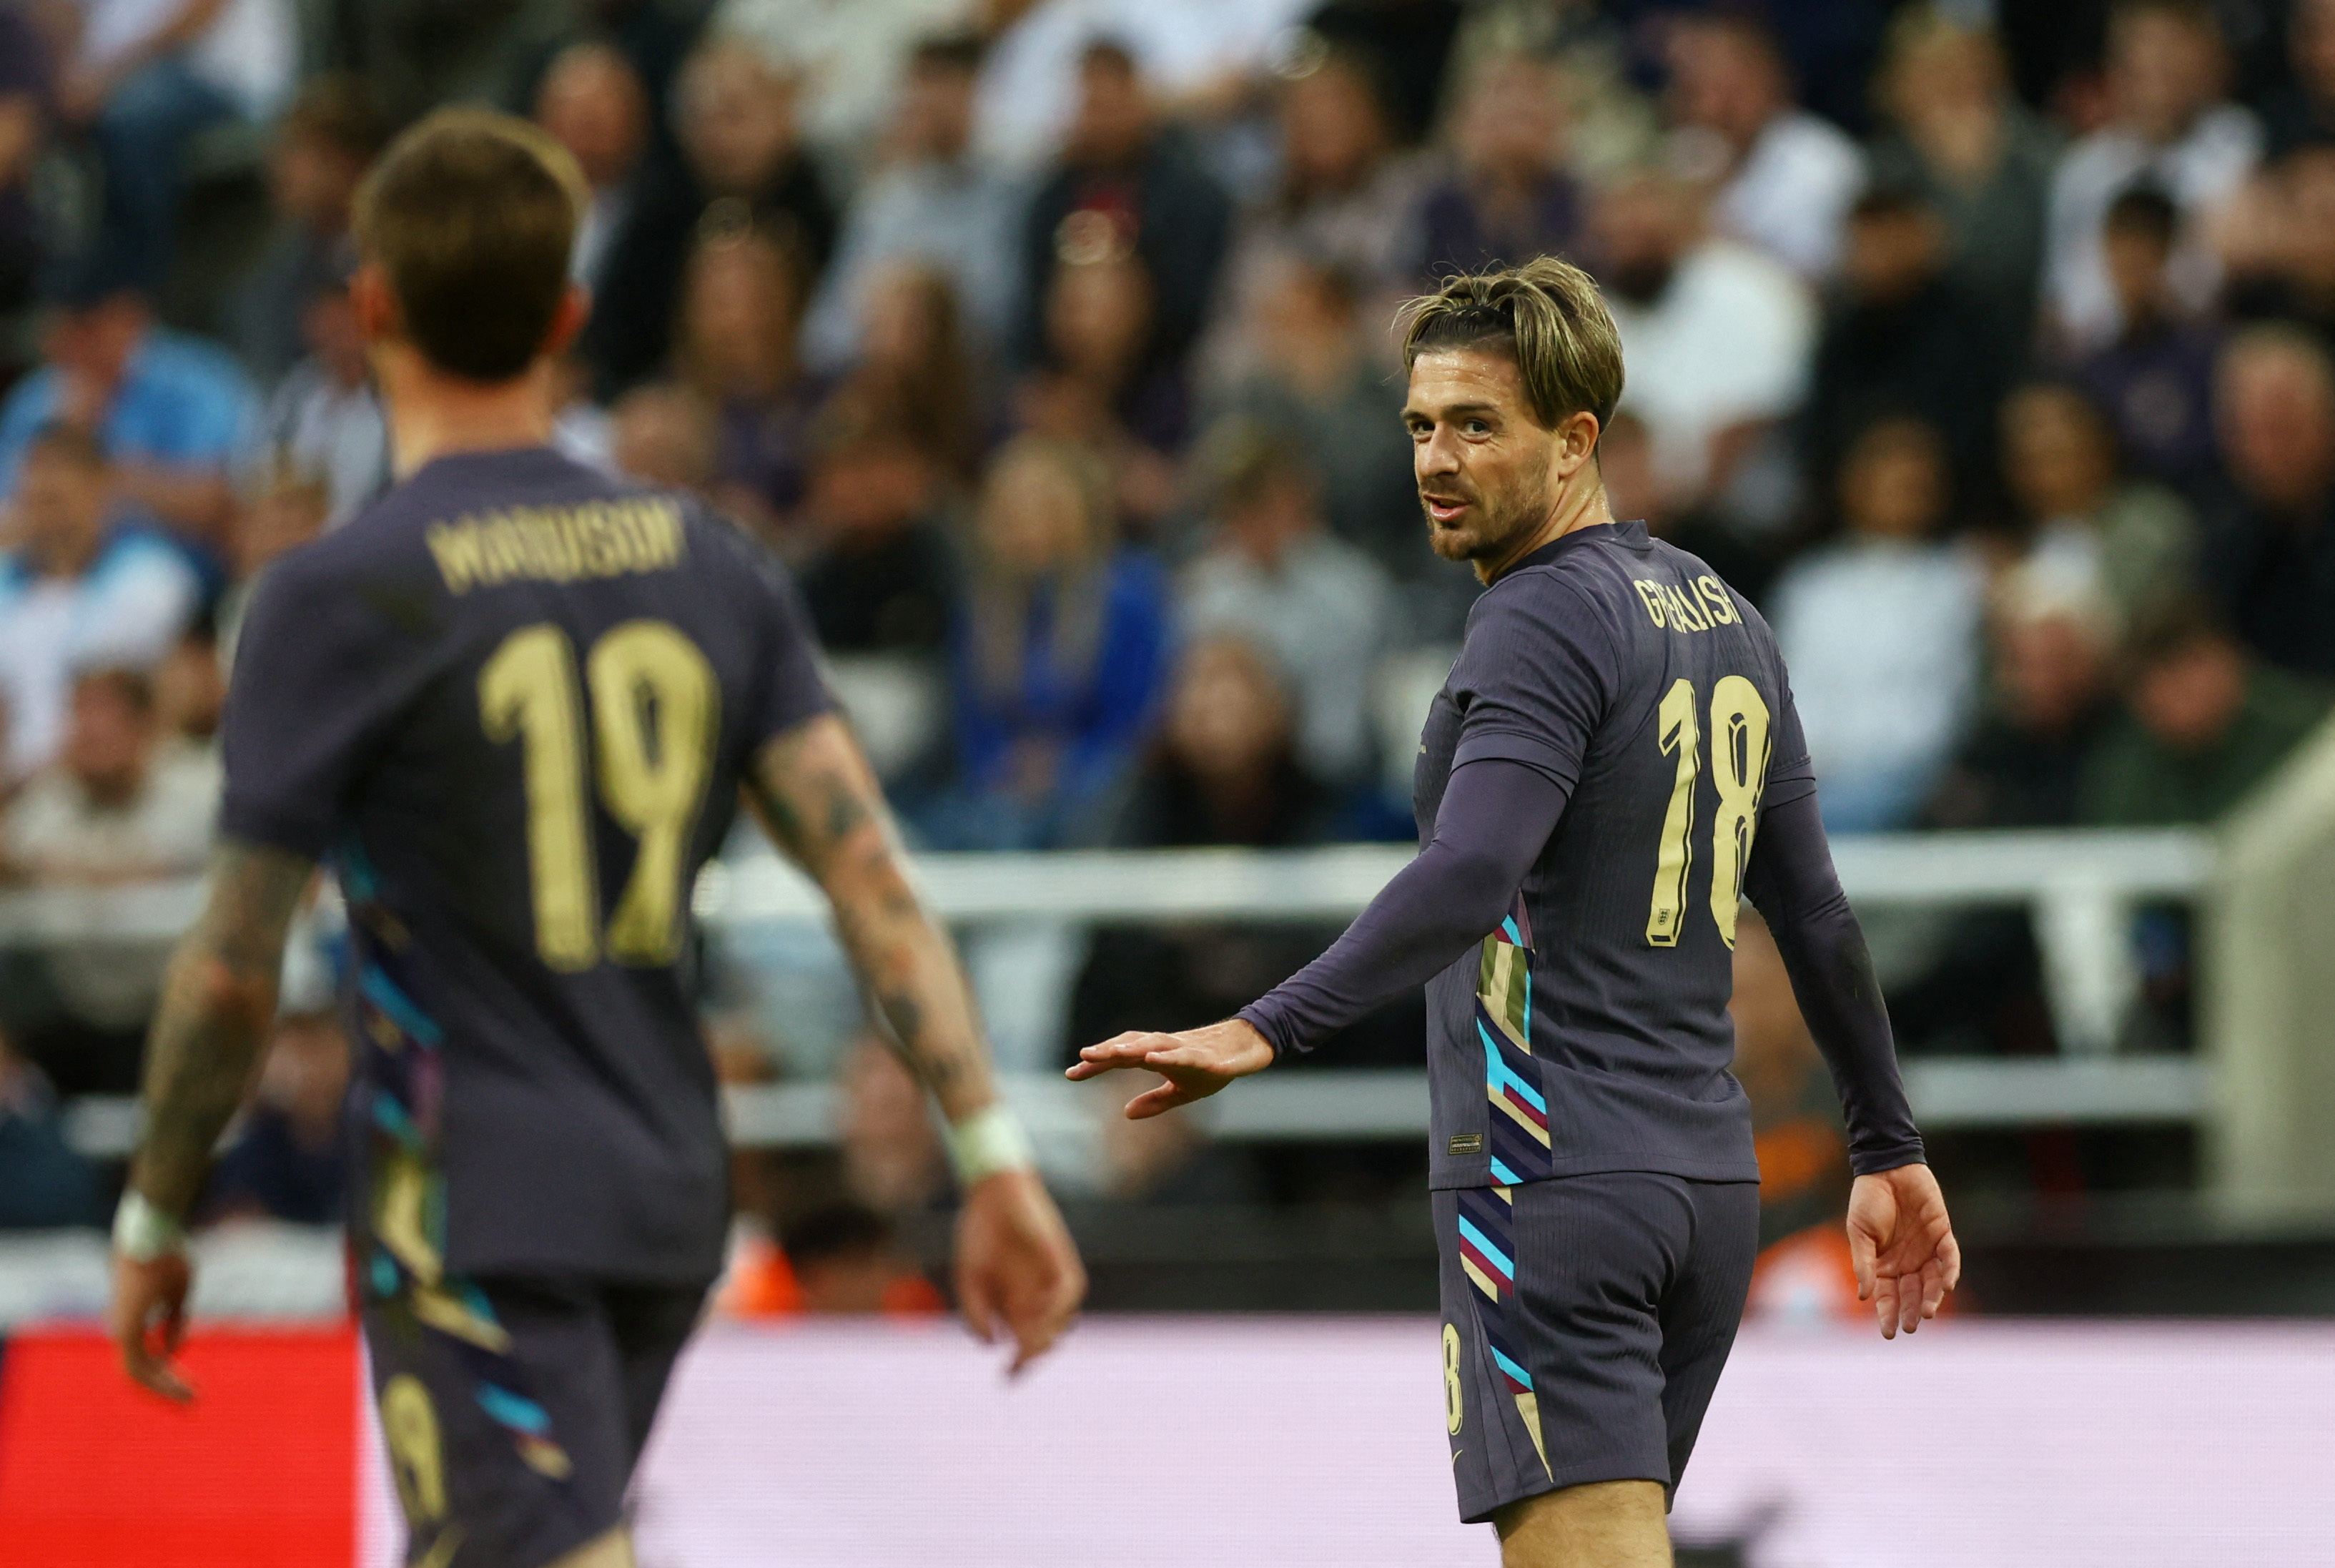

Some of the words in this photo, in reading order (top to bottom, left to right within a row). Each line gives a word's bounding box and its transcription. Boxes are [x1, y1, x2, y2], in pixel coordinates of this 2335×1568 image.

[1633, 575, 1743, 634] GREALISH
[478, 619, 721, 972] 19
[1646, 675, 1772, 952] 18
